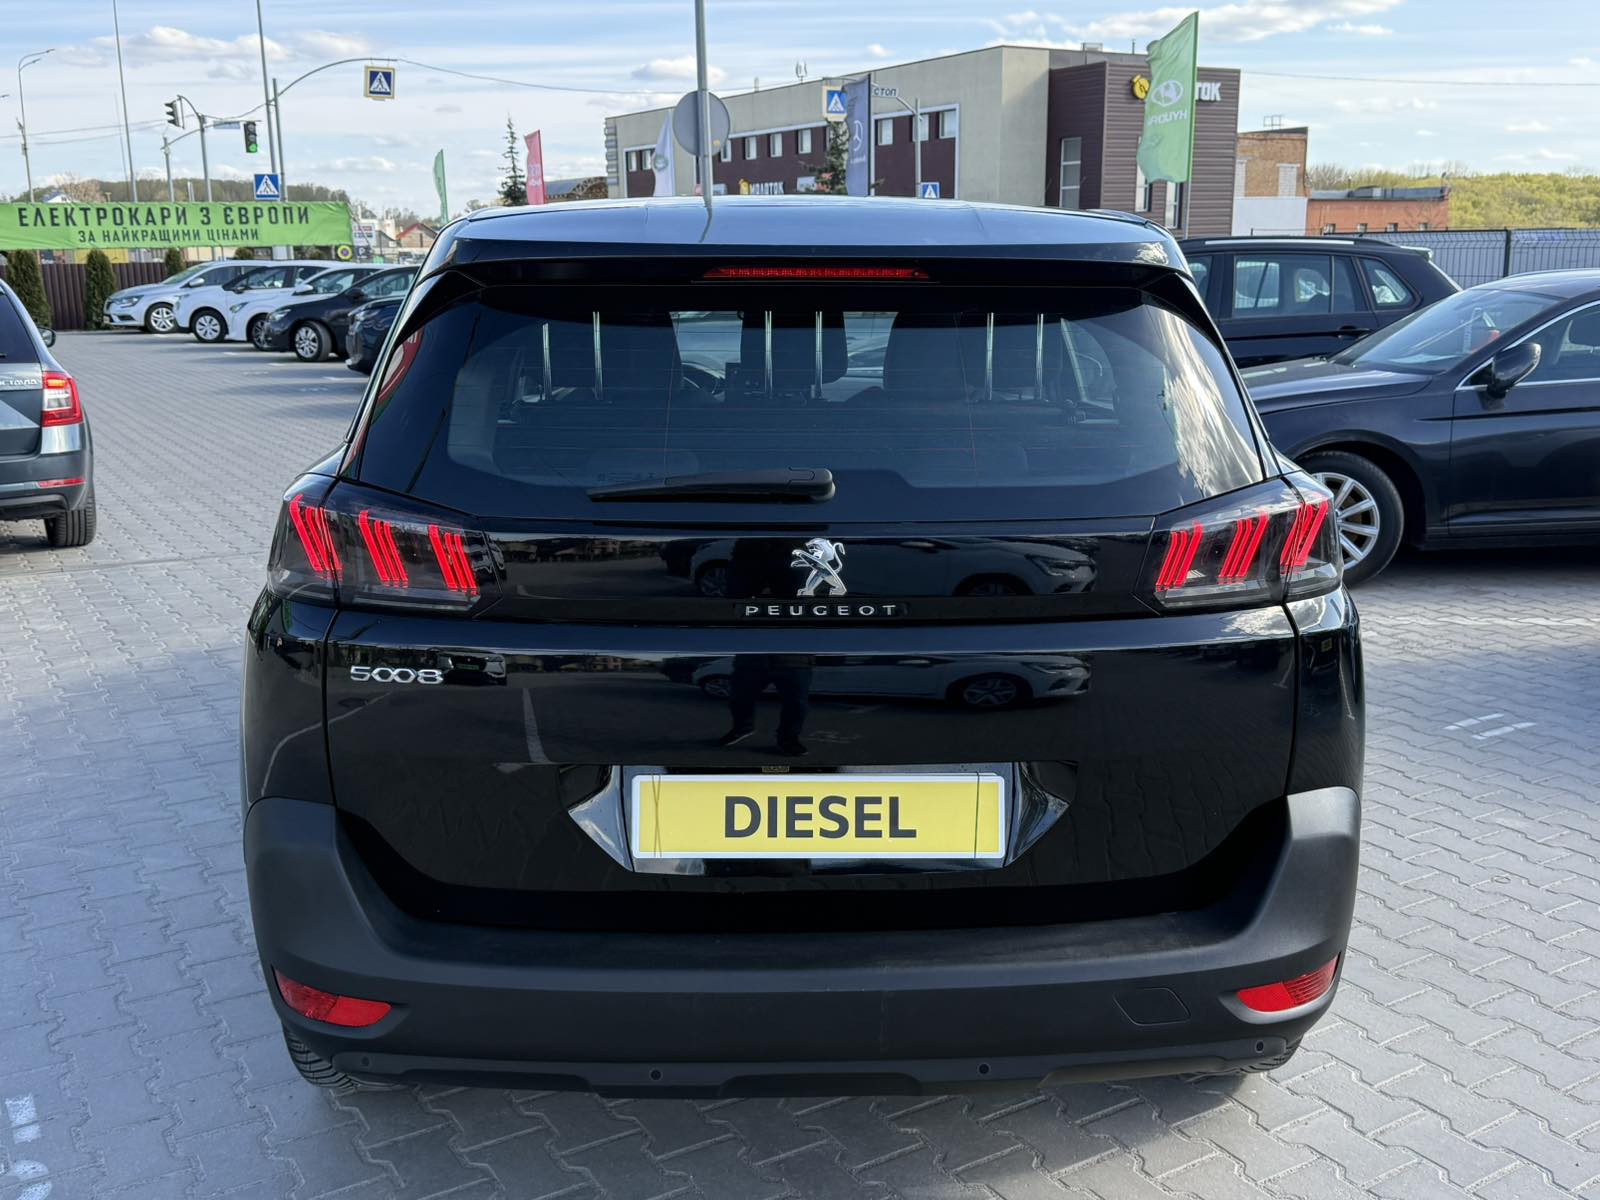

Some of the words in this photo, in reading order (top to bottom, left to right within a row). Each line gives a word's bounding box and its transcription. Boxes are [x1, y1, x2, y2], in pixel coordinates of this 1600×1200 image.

[18, 206, 187, 227] ЕЛЕКТРОКАРИ
[200, 206, 211, 226] З
[224, 206, 309, 225] ЄВРОПИ
[78, 229, 96, 242] ЗА
[102, 227, 201, 243] НАЙКРАЩИМИ
[207, 228, 260, 242] ЦІНАМИ
[745, 604, 897, 617] PEUGEOT
[350, 665, 444, 685] 5008
[724, 795, 917, 839] DIESEL
